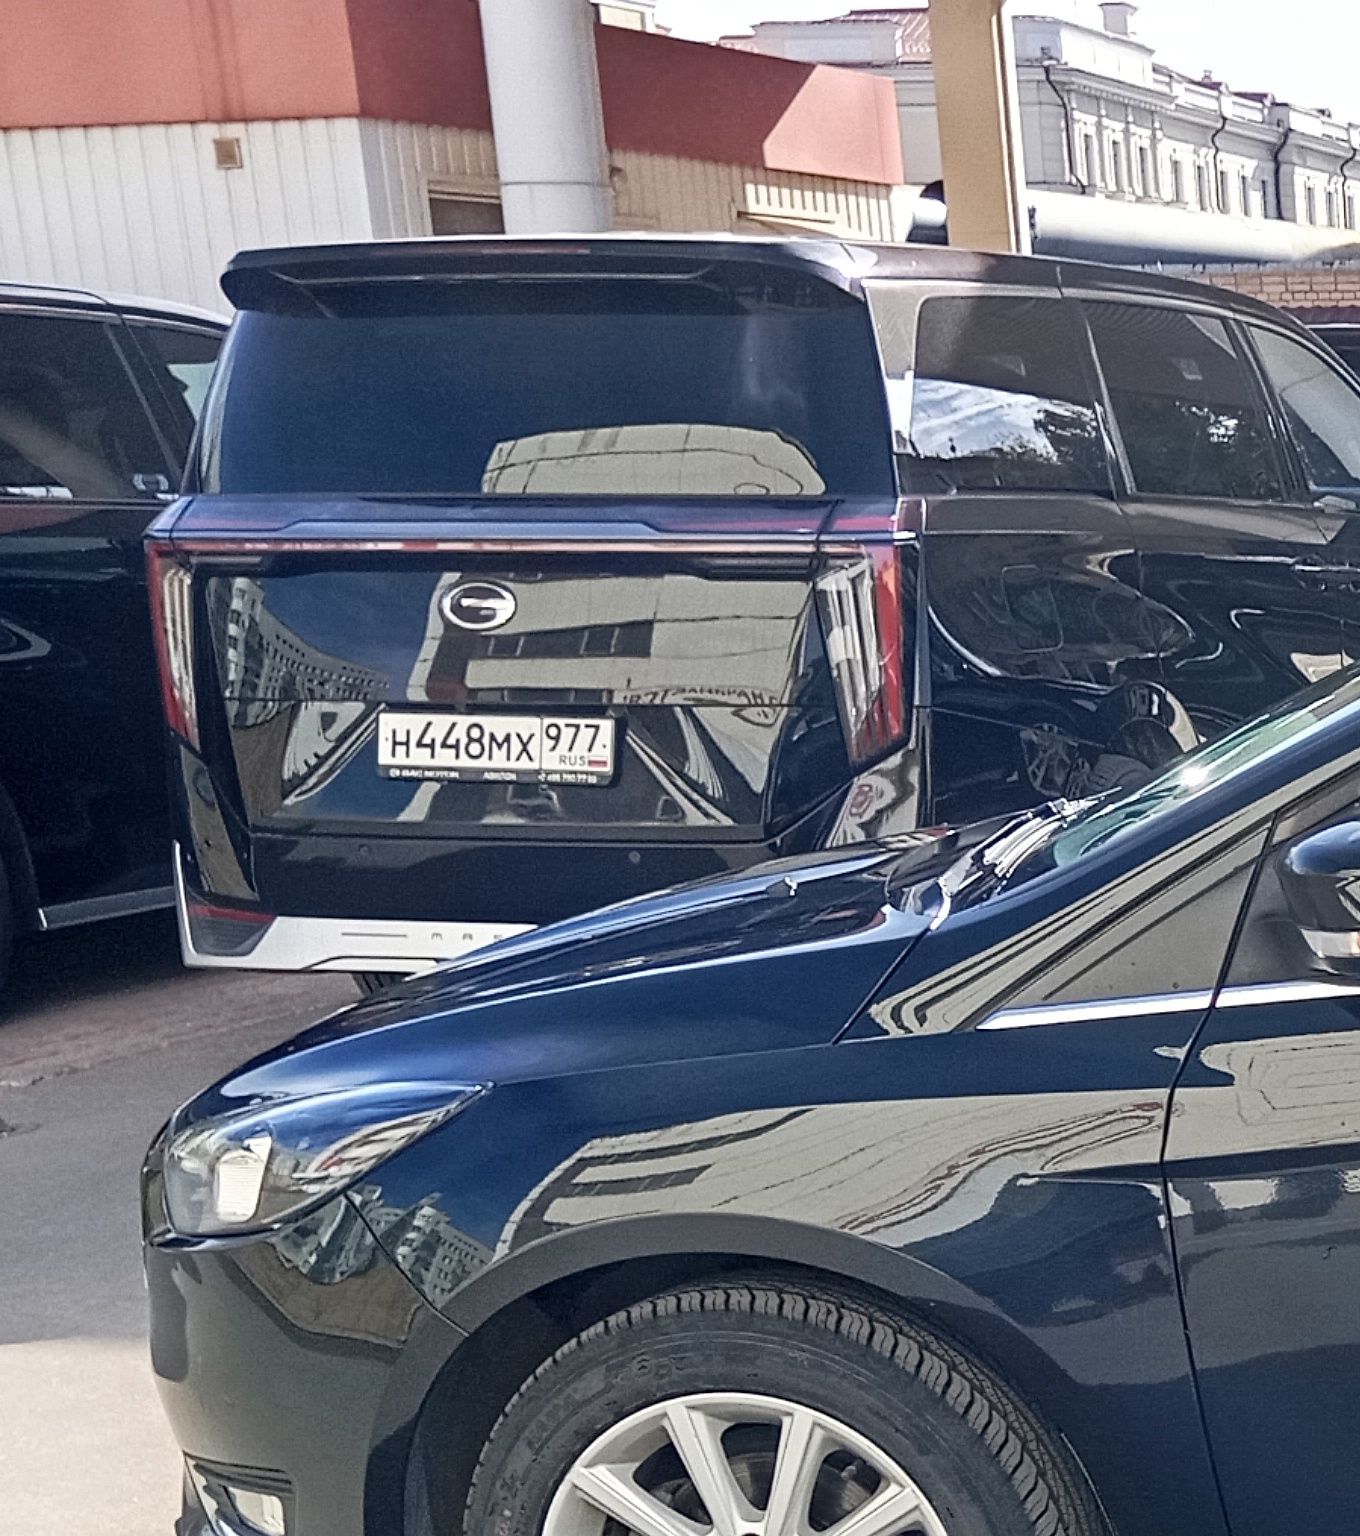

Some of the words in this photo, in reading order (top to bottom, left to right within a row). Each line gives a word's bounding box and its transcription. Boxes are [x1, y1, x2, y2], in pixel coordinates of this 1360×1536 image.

[390, 720, 536, 763] Н448МХ
[545, 722, 601, 753] 977
[558, 754, 587, 767] RUS
